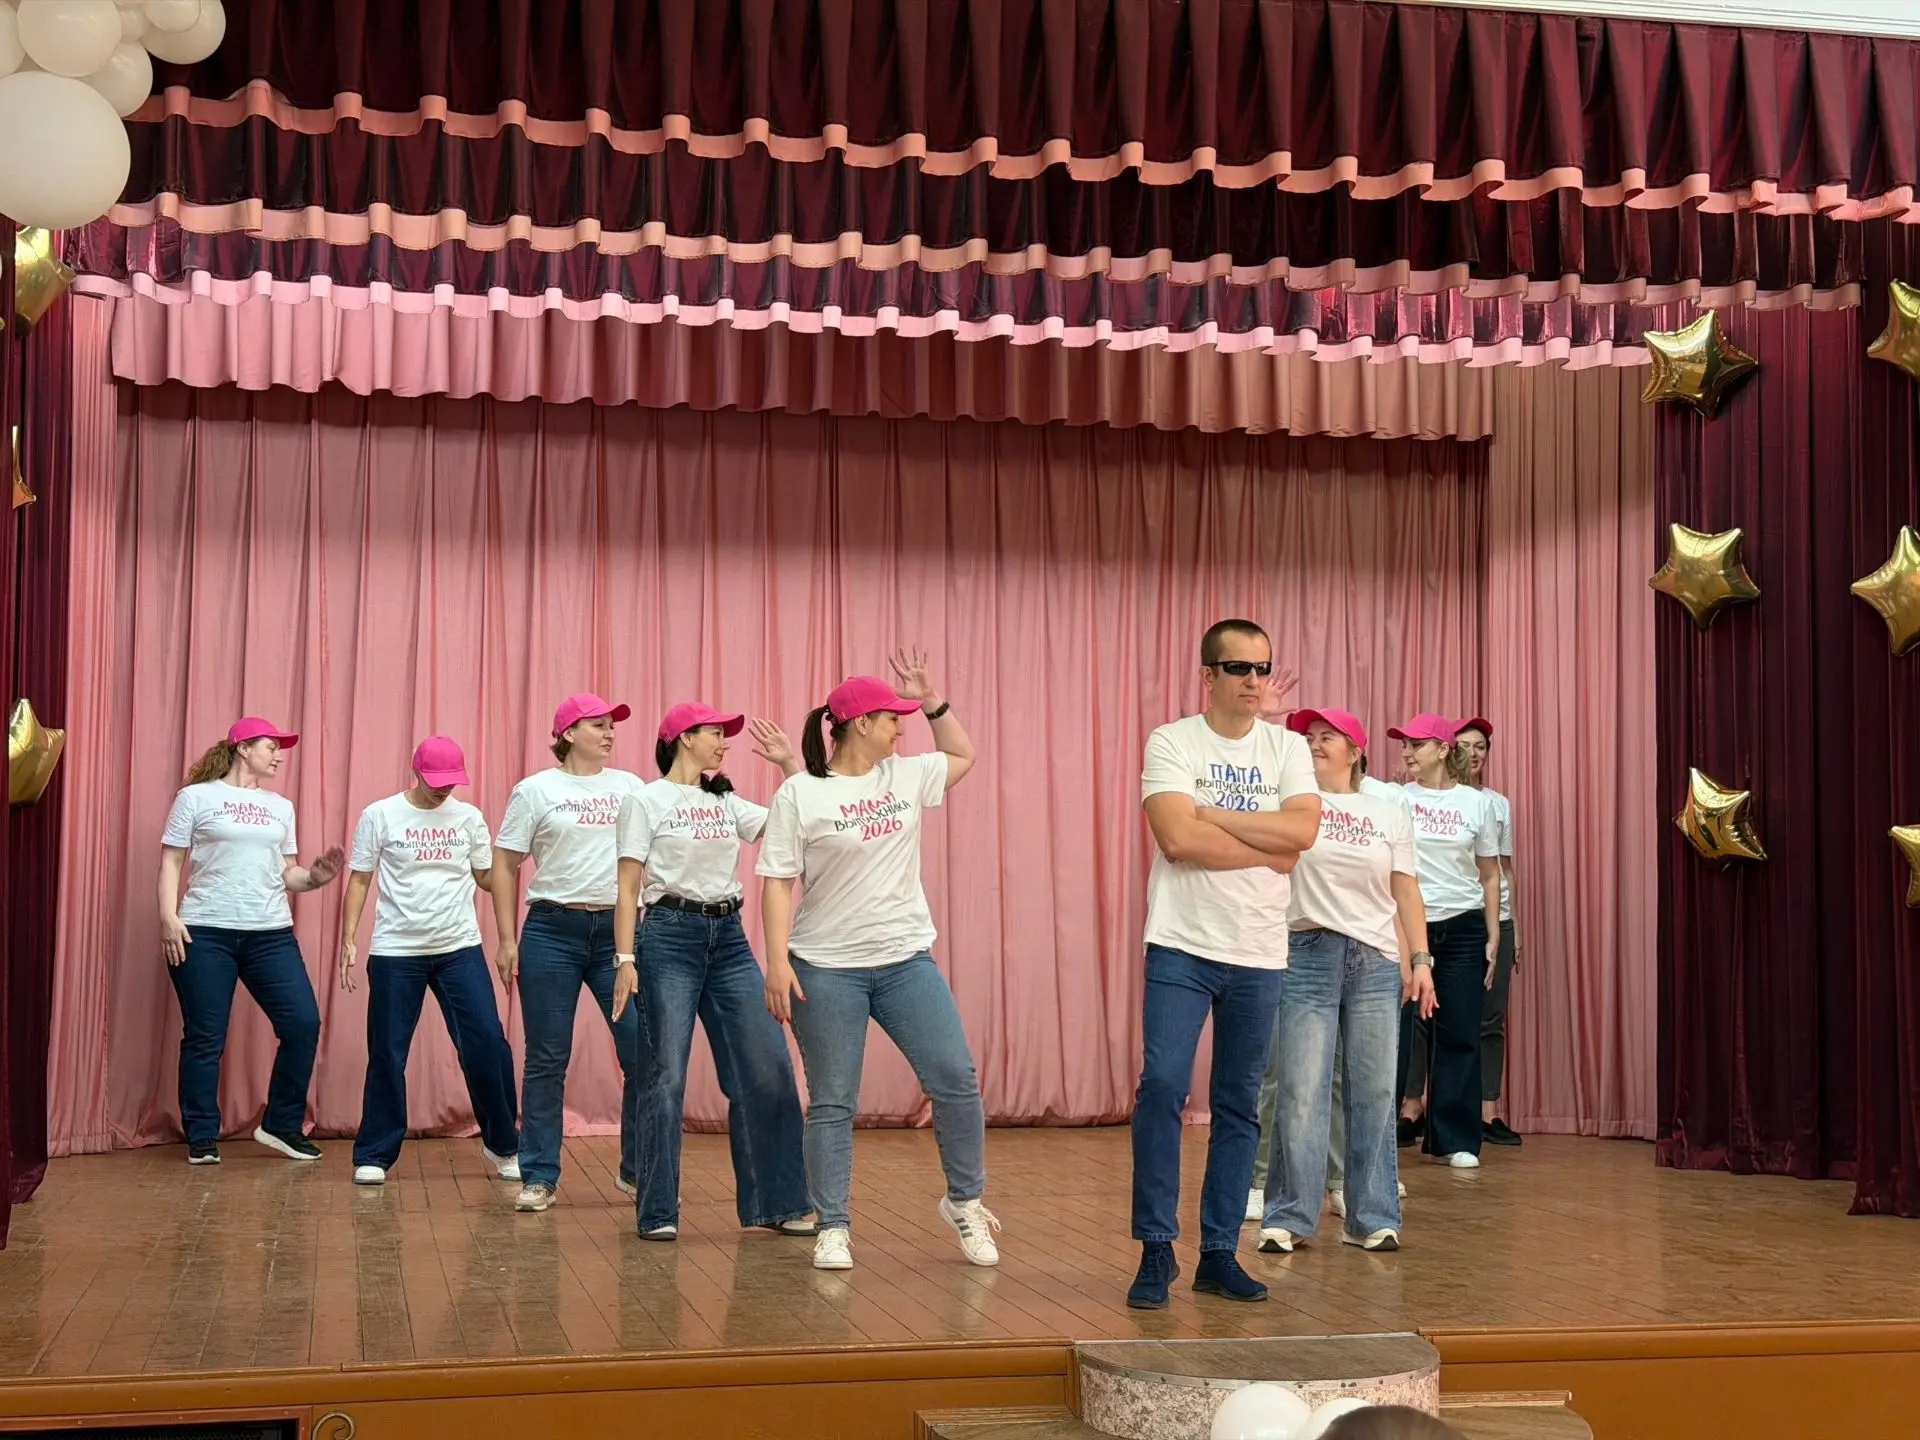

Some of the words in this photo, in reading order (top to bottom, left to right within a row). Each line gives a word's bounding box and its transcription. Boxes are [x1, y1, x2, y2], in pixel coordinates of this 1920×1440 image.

[1208, 763, 1262, 785] ПАПА
[223, 801, 272, 816] МАМА
[555, 803, 619, 813] ВЫПУСКНИ
[840, 791, 896, 818] МАМА
[1215, 790, 1259, 812] 2026
[232, 813, 270, 826] 2026
[576, 811, 617, 825] 2026
[675, 806, 725, 821] МАМА
[834, 799, 912, 832] ВЫПУСКНИКА
[1320, 809, 1374, 830] МАМА
[1415, 803, 1463, 826] МАМА
[405, 828, 457, 842] МАМА
[691, 826, 729, 840] 2026
[860, 813, 903, 842] 2026
[1320, 822, 1386, 839] ПУСКНИКА
[1420, 823, 1458, 836] 2026
[396, 838, 465, 850] ВЫПУСКНИЦЫ
[1322, 831, 1371, 847] 2026
[414, 846, 453, 862] 2026
